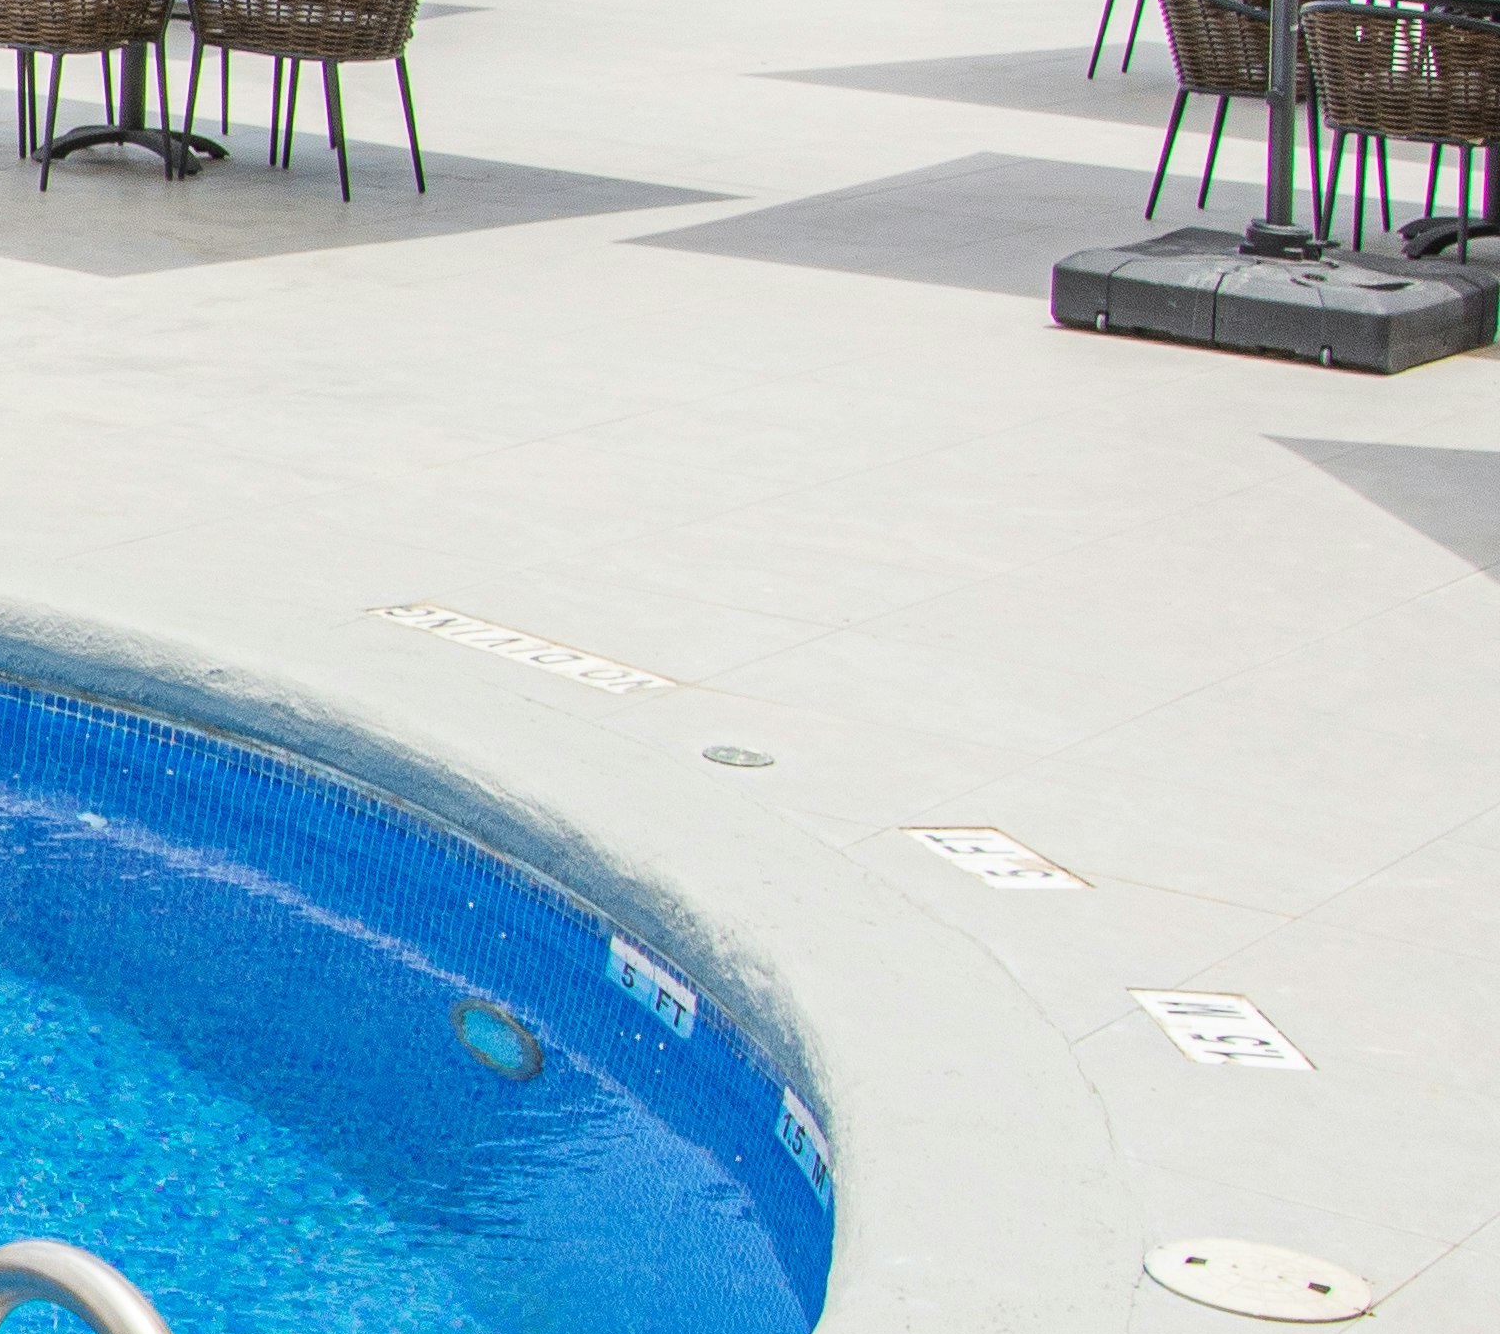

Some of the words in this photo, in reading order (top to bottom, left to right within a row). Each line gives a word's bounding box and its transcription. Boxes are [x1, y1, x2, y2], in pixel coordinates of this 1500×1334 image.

[386, 607, 581, 665] DIVING
[924, 833, 1017, 855] FT
[621, 966, 635, 988] 5
[655, 987, 687, 1028] FT
[1157, 1000, 1247, 1019] M
[782, 1113, 807, 1156] 1.5
[811, 1153, 829, 1194] M
